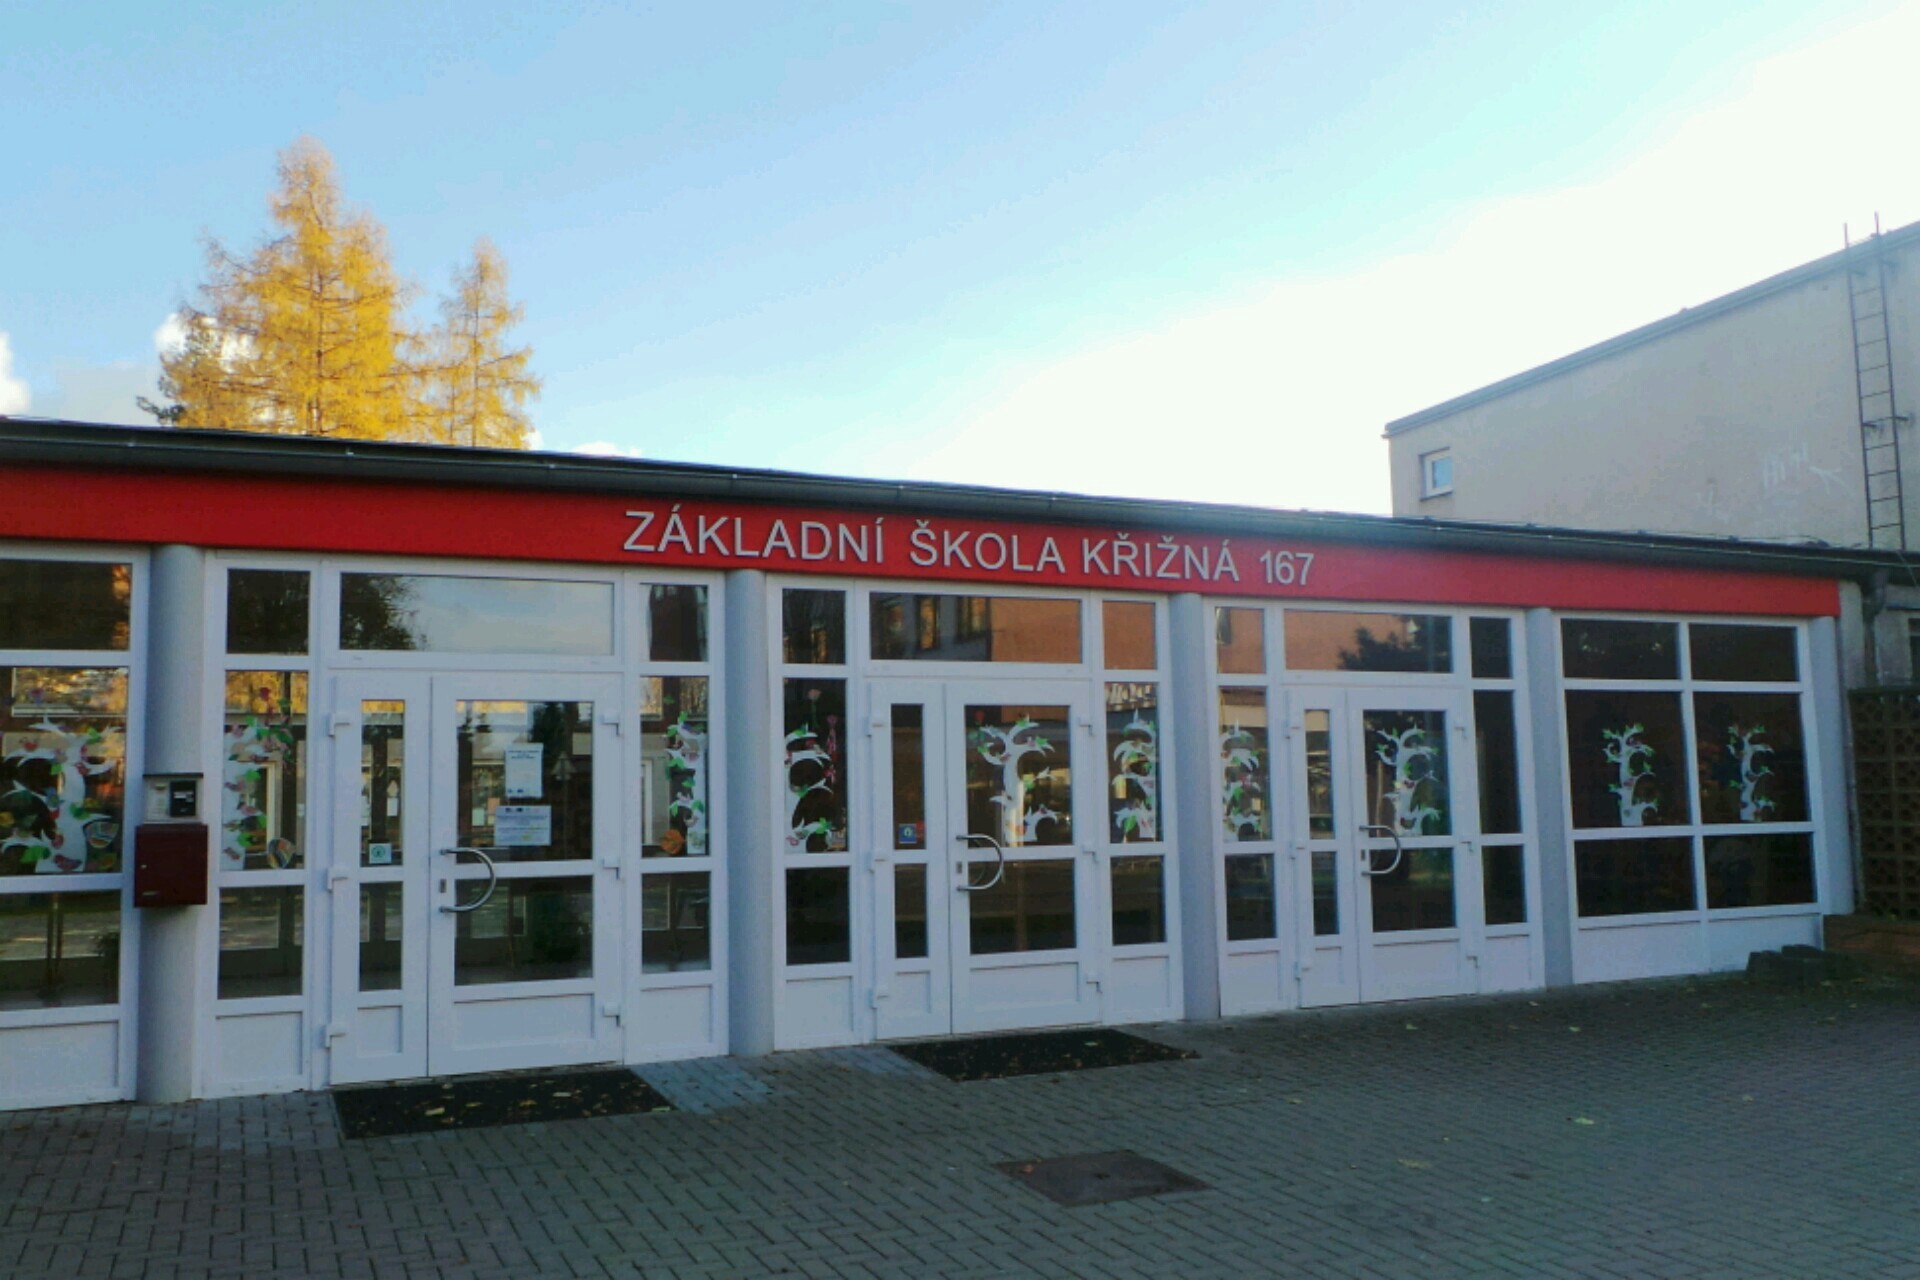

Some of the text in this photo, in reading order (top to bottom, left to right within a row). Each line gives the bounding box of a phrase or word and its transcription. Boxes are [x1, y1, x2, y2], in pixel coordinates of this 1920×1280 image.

[623, 504, 1315, 586] ZÁKLADNÍ ŠKOLA KŘIŽNÁ 167
